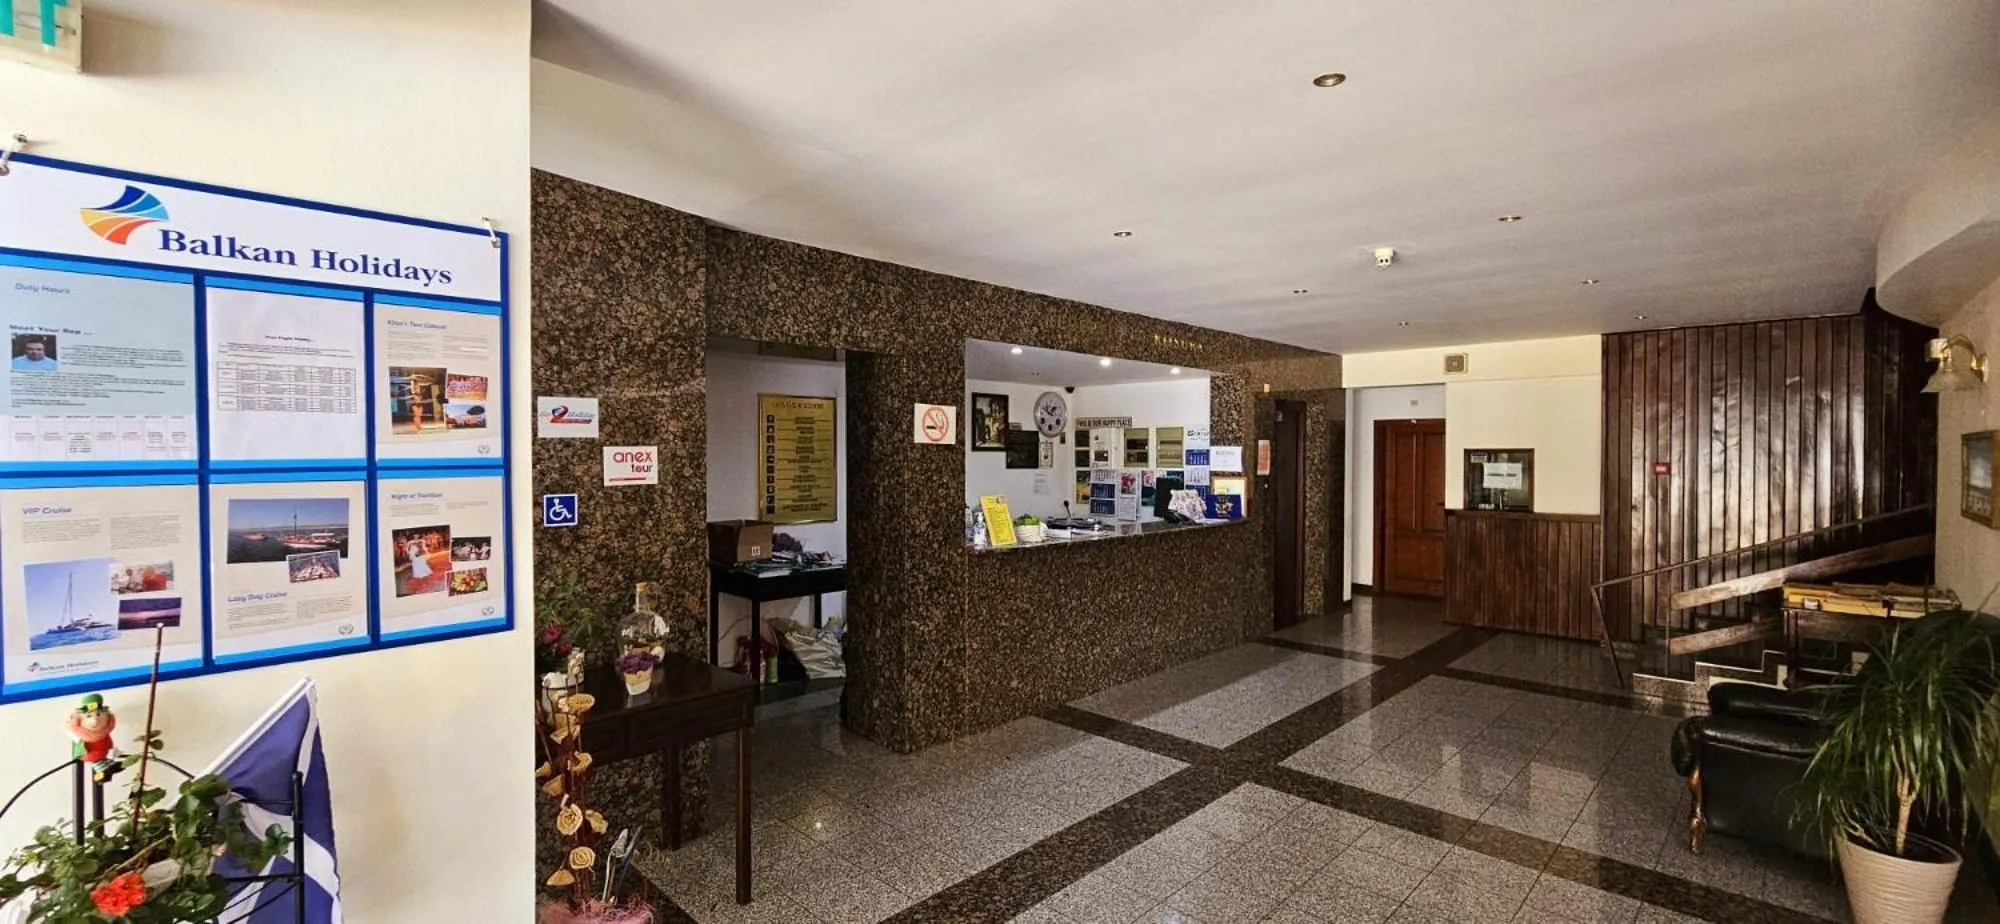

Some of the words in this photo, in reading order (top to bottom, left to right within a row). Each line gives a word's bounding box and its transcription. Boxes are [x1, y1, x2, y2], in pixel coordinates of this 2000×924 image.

[158, 229, 298, 266] Balkan
[310, 248, 453, 286] Holidays
[15, 282, 39, 292] Duty
[41, 285, 71, 294] Hours
[613, 451, 653, 463] anex
[631, 464, 653, 473] tour
[22, 507, 41, 515] VIP
[42, 506, 72, 514] Cruise
